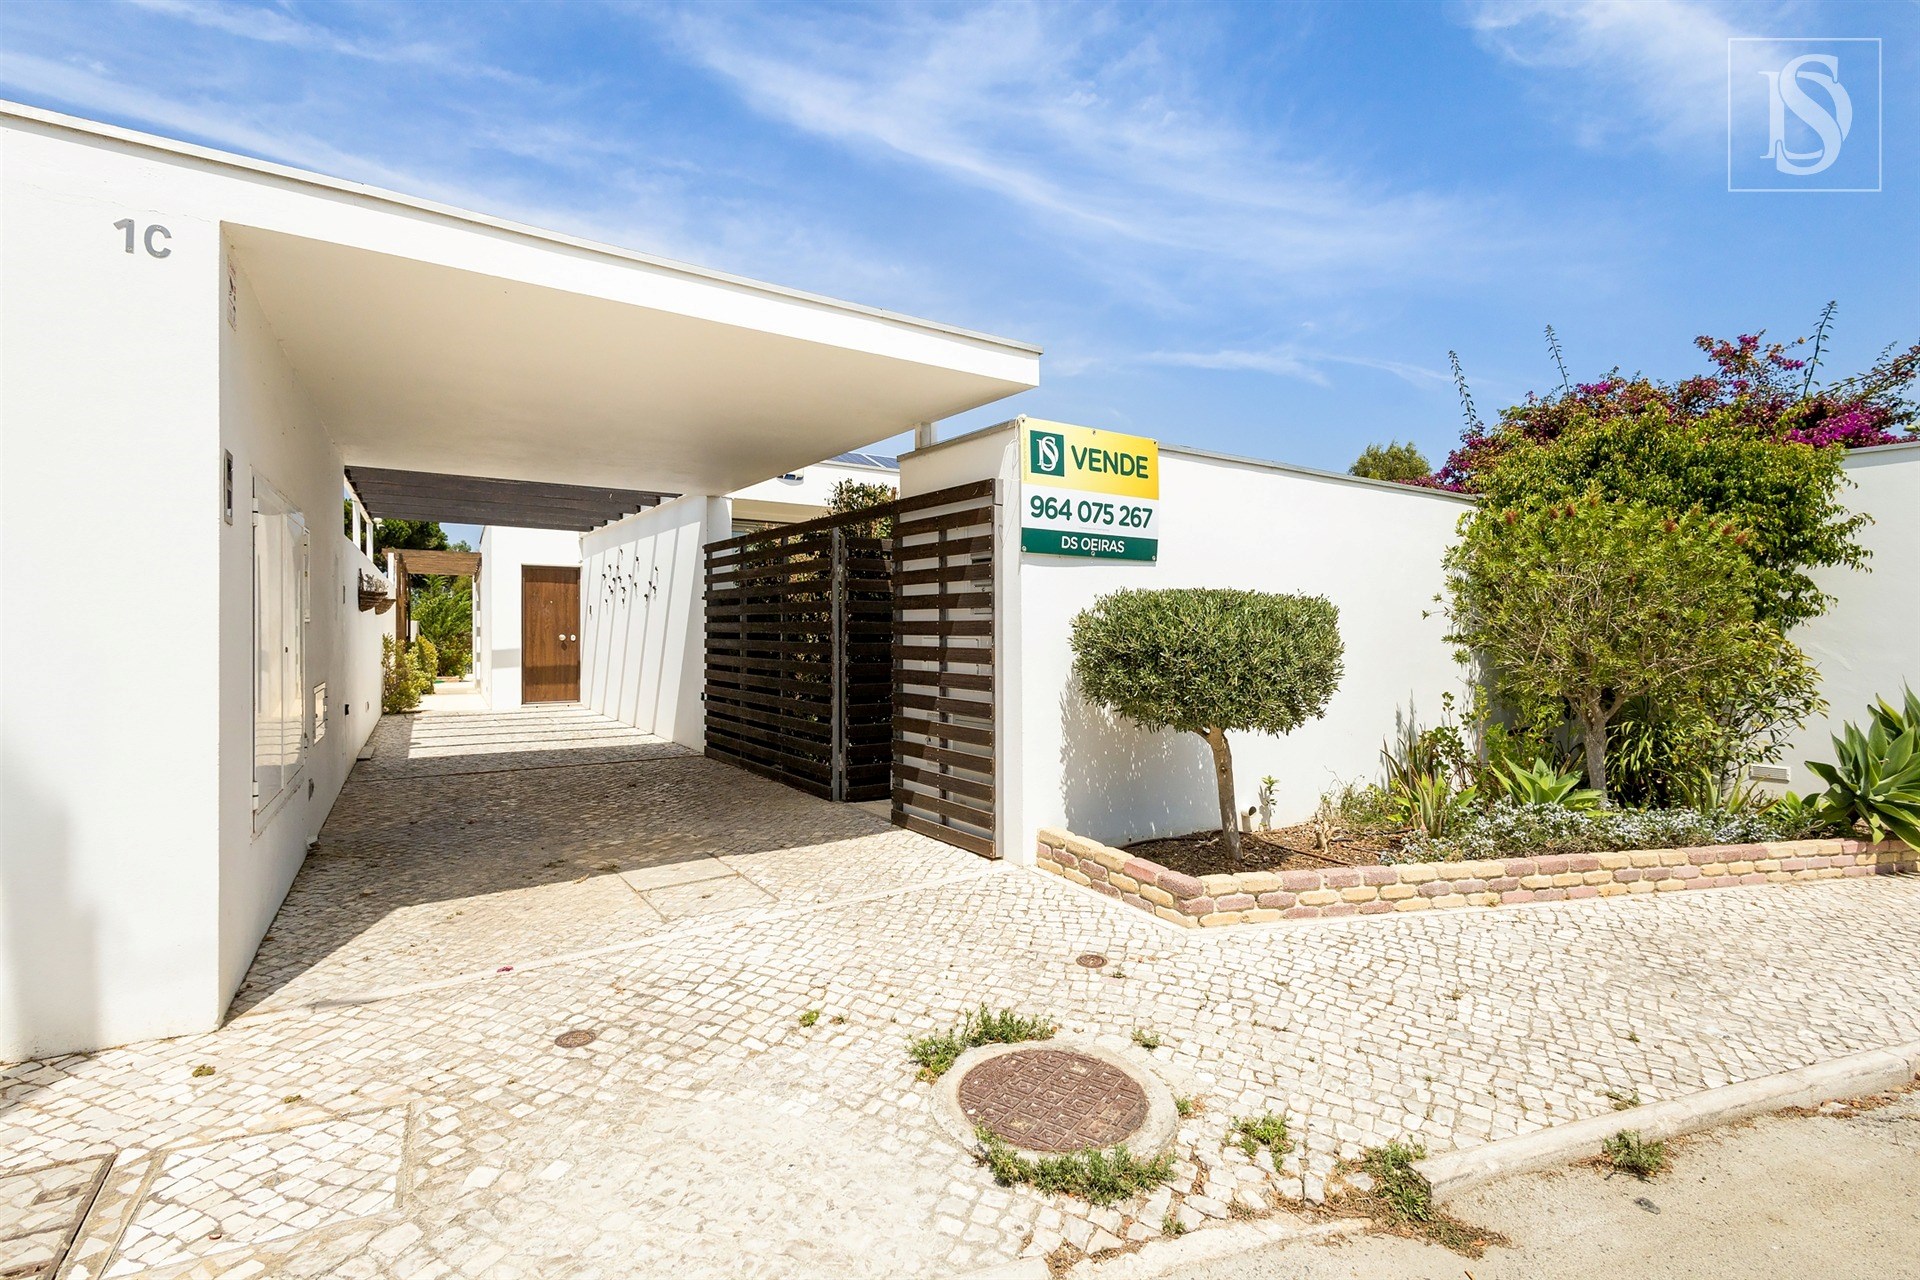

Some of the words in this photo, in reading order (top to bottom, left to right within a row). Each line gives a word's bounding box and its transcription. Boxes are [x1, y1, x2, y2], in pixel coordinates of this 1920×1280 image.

[113, 218, 172, 259] 1C
[1071, 445, 1149, 479] VENDE
[1030, 495, 1072, 521] 964
[1078, 500, 1114, 525] 075
[1119, 505, 1153, 529] 267
[1061, 535, 1078, 549] DS
[1081, 537, 1125, 553] OEIRAS
